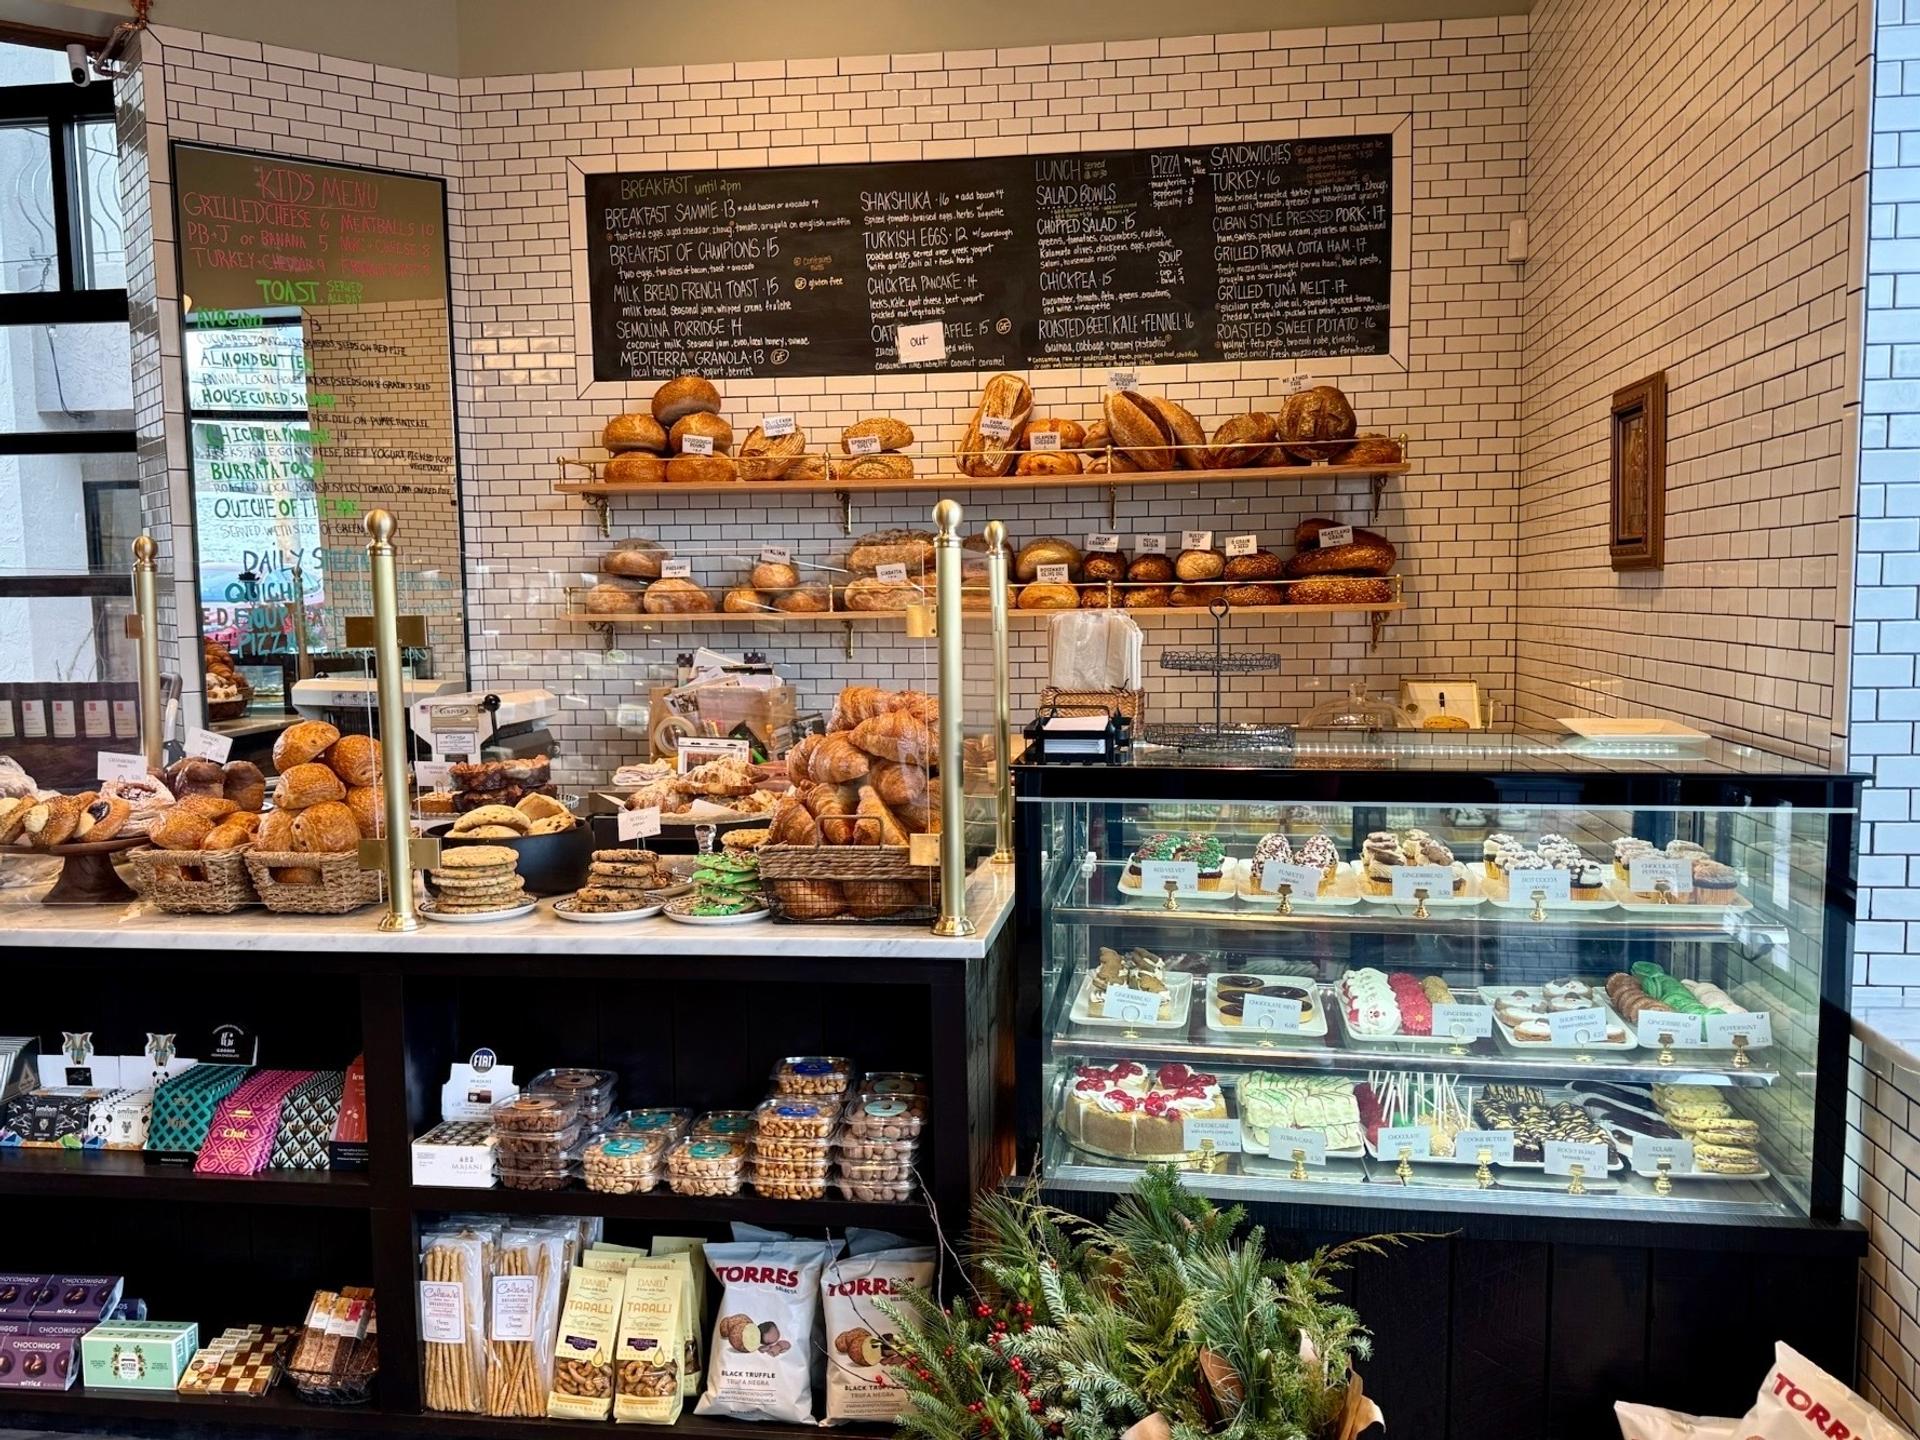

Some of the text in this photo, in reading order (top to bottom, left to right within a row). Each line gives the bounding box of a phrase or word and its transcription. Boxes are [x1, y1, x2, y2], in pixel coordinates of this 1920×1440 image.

[1151, 153, 1181, 175] PIZZA
[1211, 143, 1291, 166] SANDWICHES
[1035, 159, 1081, 181] LUNCH
[1209, 169, 1261, 191] TURKEY
[321, 177, 379, 209] MENU
[621, 175, 742, 200] BREAKFAST until 2pm
[1036, 183, 1116, 205] SALAD BOWLS
[1234, 191, 1257, 201] brined
[860, 191, 932, 212] SHAKSHUKA
[183, 191, 265, 225] GRILLED
[265, 203, 313, 229] CHEESE
[340, 214, 415, 236] MEATBALLS
[605, 197, 720, 230] BREAKFAST SAMMIE
[1212, 215, 1247, 232] CUBAN
[1249, 211, 1283, 229] STYLE
[1286, 208, 1333, 225] PRESSED
[1335, 205, 1367, 222] PORK
[861, 225, 916, 249] TURKISH
[920, 227, 949, 247] EGGS
[1037, 217, 1118, 235] CHOPPED SALAD
[260, 230, 307, 249] BANANA
[319, 235, 329, 253] 5
[609, 238, 761, 266] BREAKFAST OF CHAMPIONS
[1214, 240, 1350, 262] GRILLED PARMA COTTA HAM
[1158, 249, 1183, 265] SOUP
[920, 272, 963, 291] PANCAKE
[1040, 269, 1098, 291] CHICKPEA
[1257, 271, 1297, 282] sourdough
[256, 279, 319, 303] TOAST
[613, 278, 759, 302] MILK BREAD FRENCH TOAST
[1217, 279, 1330, 300] GRILLED TUNA MELT
[196, 309, 263, 329] AVOCADO
[622, 306, 643, 317] milk
[616, 316, 725, 339] SEMOLINA PORRIDGE
[1038, 315, 1138, 341] ROASTED KALE
[1216, 317, 1358, 339] ROASTED SWEET POTATO
[626, 339, 660, 350] coconut
[909, 334, 929, 348] out
[200, 349, 259, 368] ALMOND
[620, 351, 750, 367] MEDITERRA GRANOLA
[978, 355, 1006, 367] caramel
[631, 365, 649, 377] local
[202, 389, 247, 404] HOUSE
[248, 391, 289, 405] CURED
[210, 460, 278, 481] BURRATA
[215, 498, 297, 520] QUICHE OF
[243, 543, 305, 575] DAILY
[473, 1054, 493, 1068] FIAT
[715, 1265, 800, 1288] TORRES
[568, 1300, 614, 1314] TARALLI
[627, 1302, 673, 1314] TARALLI
[12, 1341, 61, 1350] CHOCOHIGOS
[721, 1369, 776, 1379] BLACK TRUFFLE
[1770, 1372, 1864, 1440] TORR
